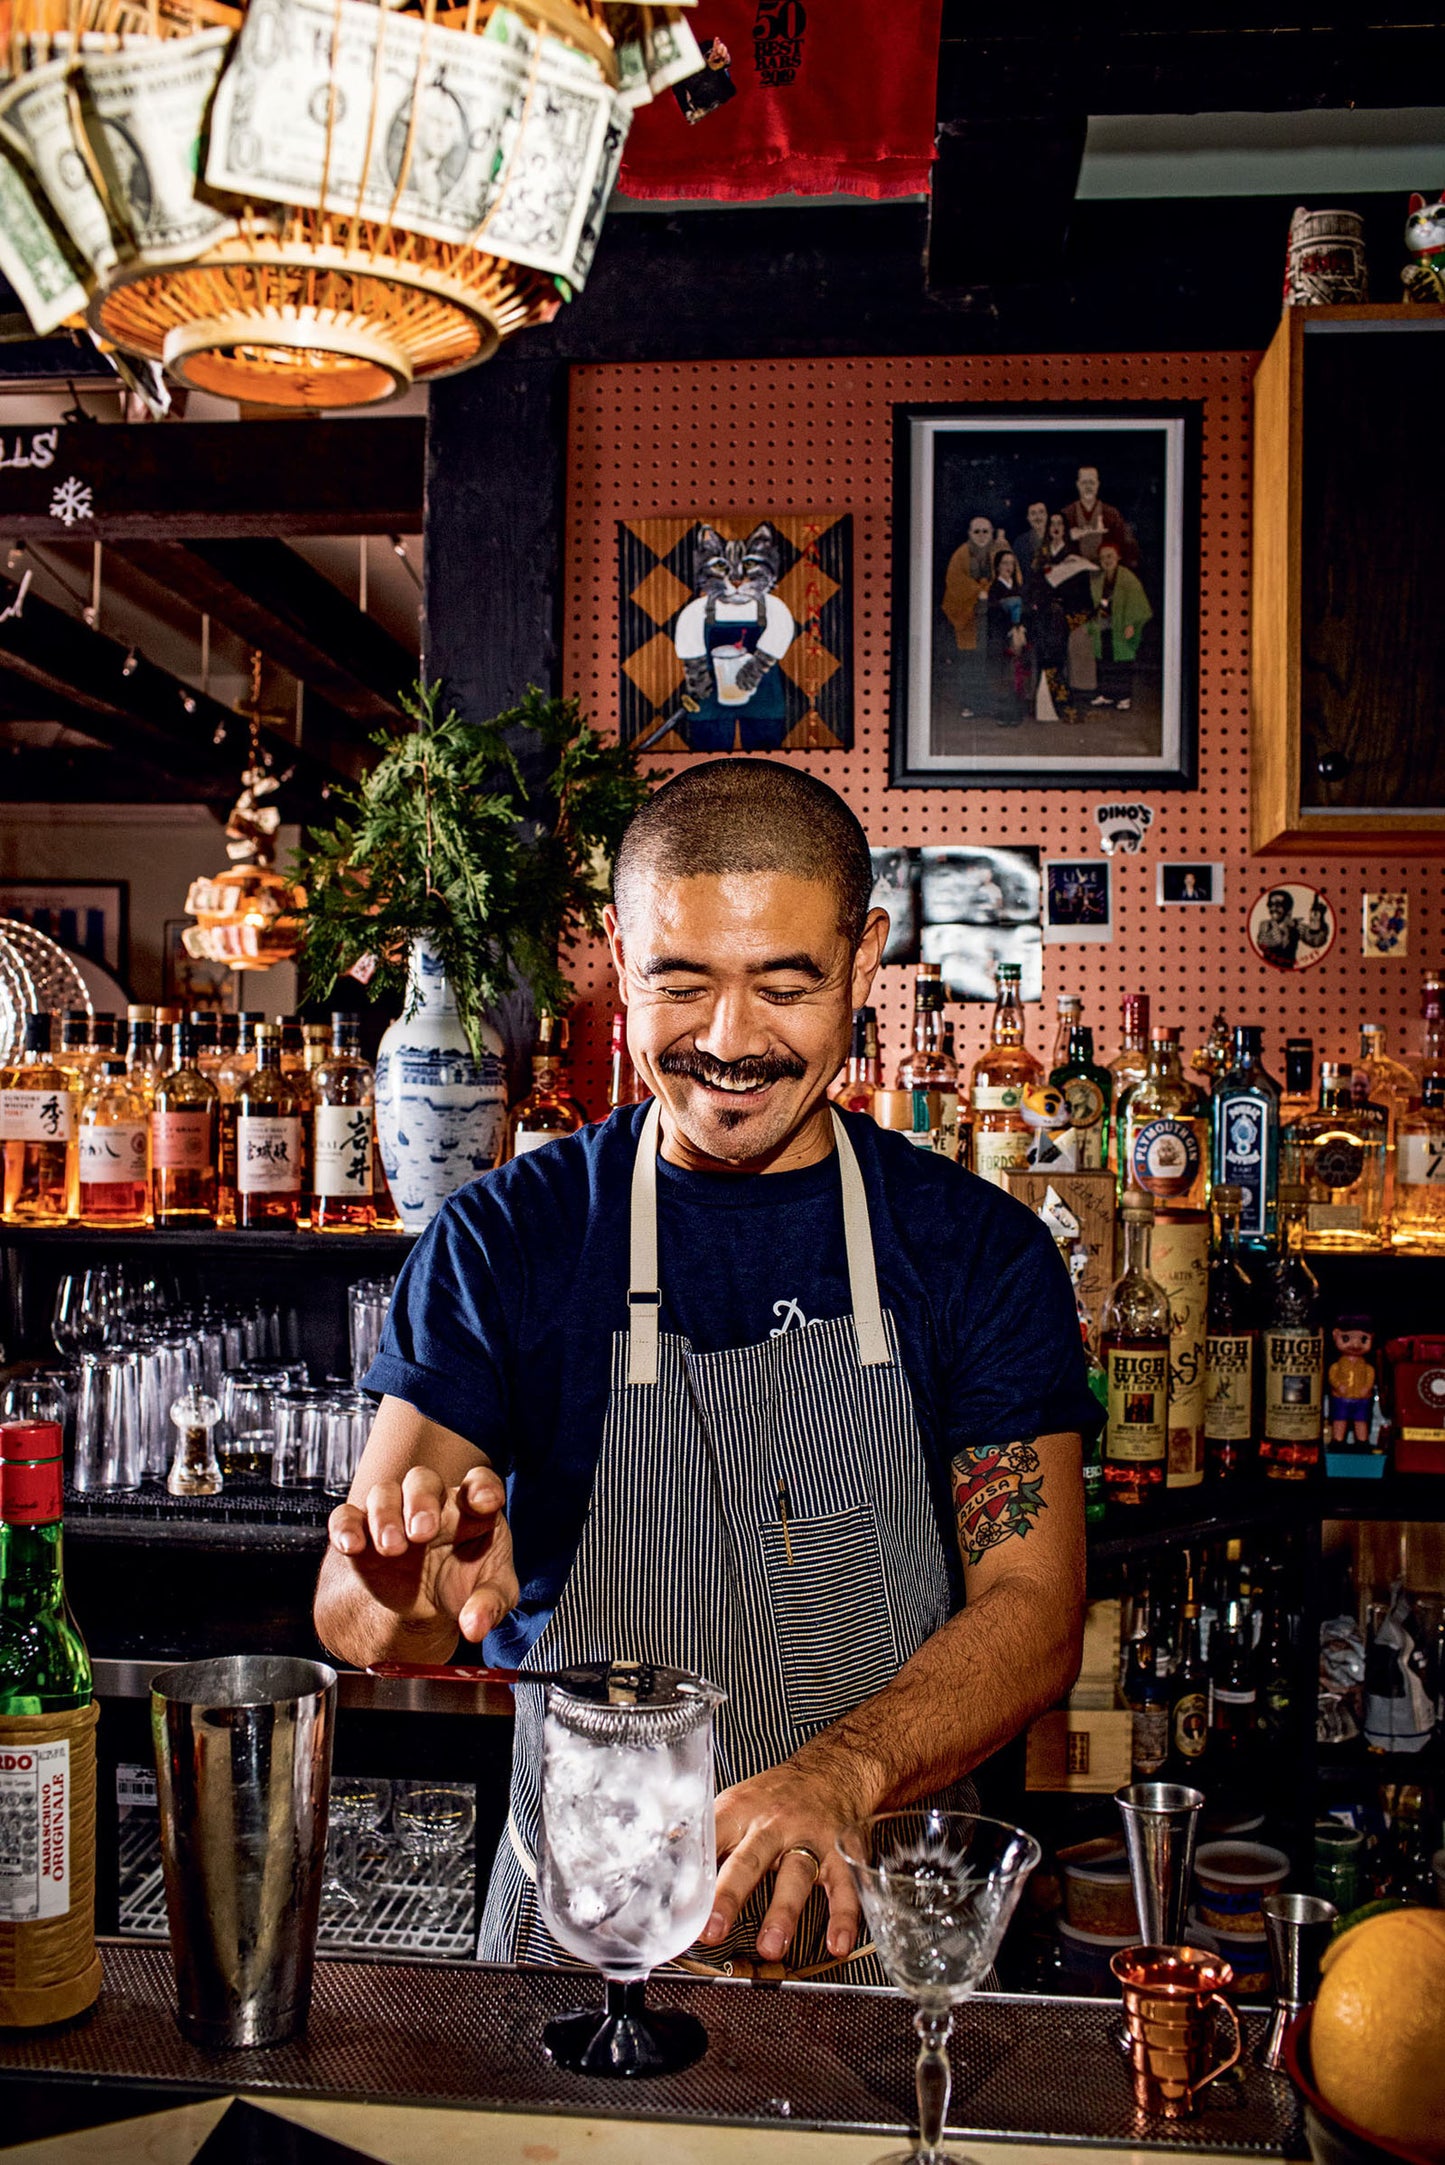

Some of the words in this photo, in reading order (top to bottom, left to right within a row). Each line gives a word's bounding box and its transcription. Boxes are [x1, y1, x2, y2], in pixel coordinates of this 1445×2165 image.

[752, 0, 807, 39] 50
[753, 40, 804, 57] BEST
[755, 56, 802, 71] BARS
[760, 69, 796, 86] 2019
[1098, 804, 1153, 824] DINO'S
[340, 1110, 371, 1188] 岩井
[1135, 1121, 1190, 1161] PLYMOUTH
[1185, 1136, 1197, 1161] GIN
[980, 1154, 1015, 1170] FORDS
[769, 1297, 824, 1339] D
[1271, 1338, 1322, 1355] HIGH
[1114, 1356, 1164, 1373] HIGH
[1272, 1353, 1321, 1366] WEST
[1115, 1373, 1164, 1384] WEST
[960, 1479, 1010, 1524] AZUSA
[0, 1754, 33, 1771] DO
[42, 1783, 52, 1876] MARASCHINO
[52, 1773, 65, 1882] ORIGINALE
